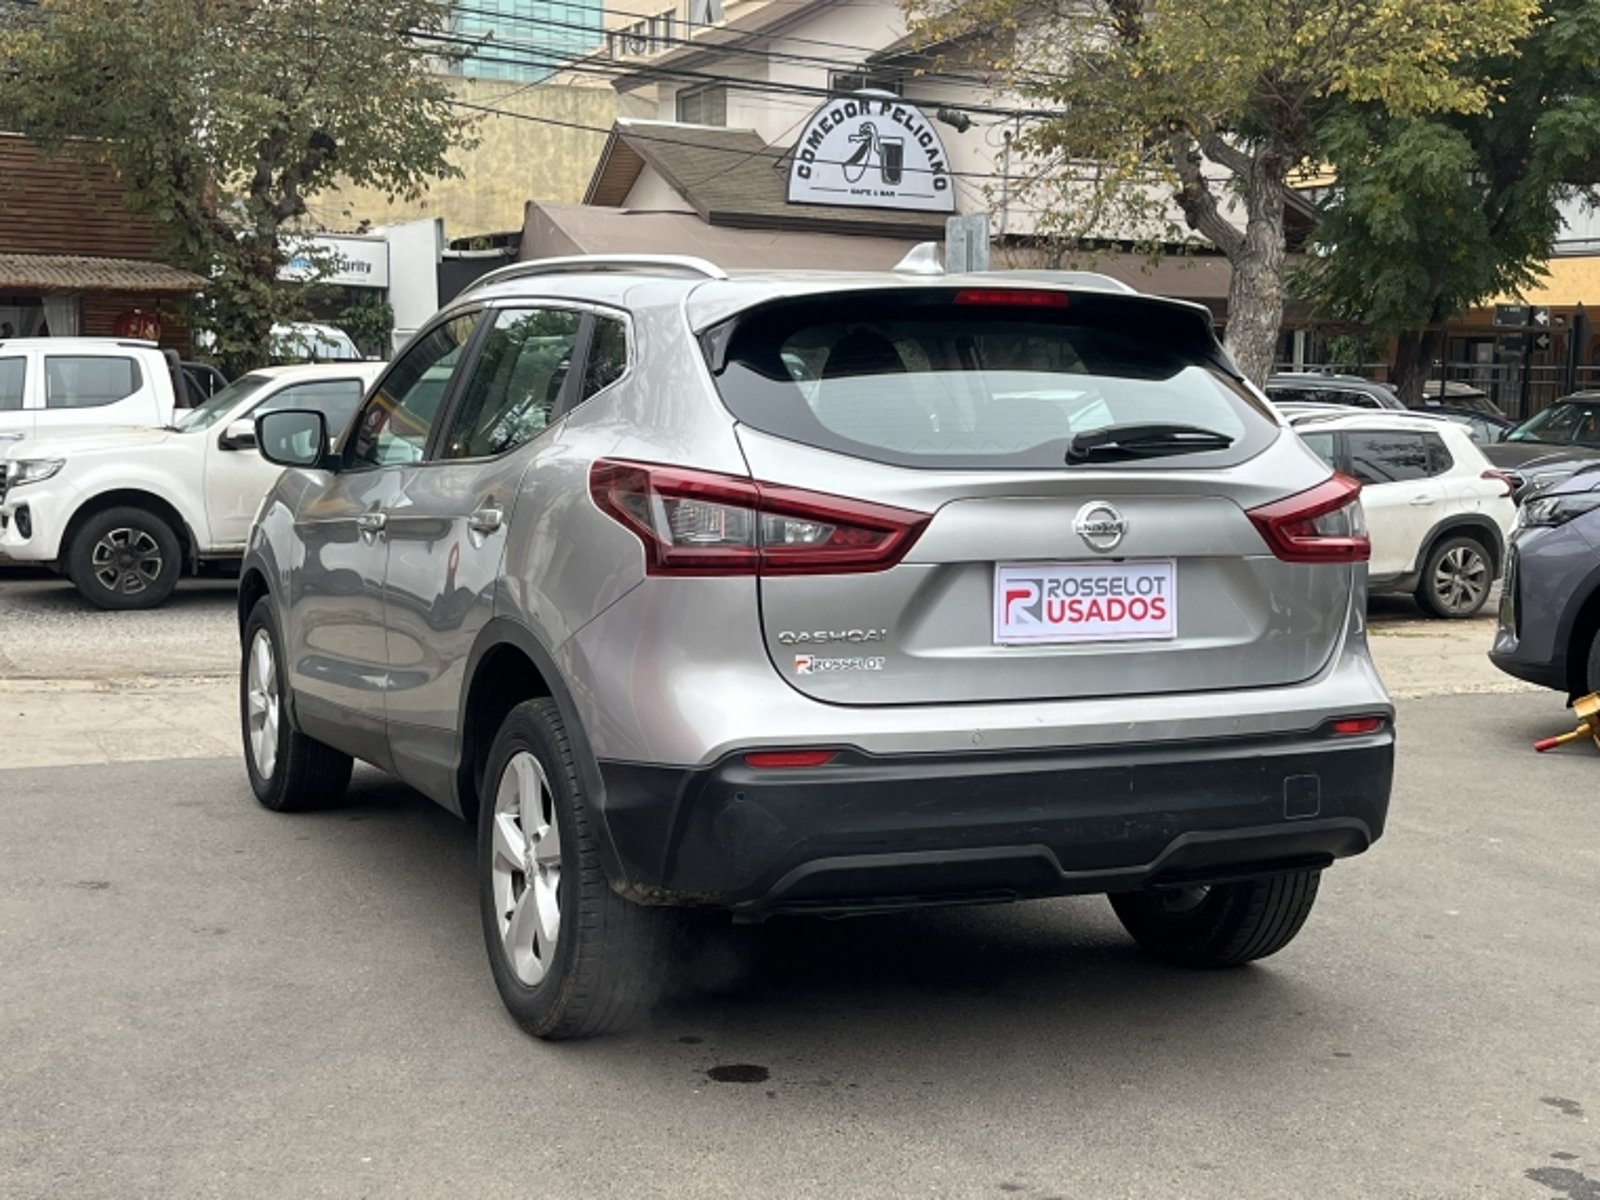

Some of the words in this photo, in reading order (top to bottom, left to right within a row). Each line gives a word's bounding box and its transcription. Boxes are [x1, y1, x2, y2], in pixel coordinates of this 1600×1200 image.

[797, 99, 871, 180] COMEDOR
[879, 101, 948, 192] PELICANO
[1047, 576, 1166, 598] ROSSELOT
[1047, 597, 1167, 624] USADOS
[778, 629, 888, 644] QASHQAI
